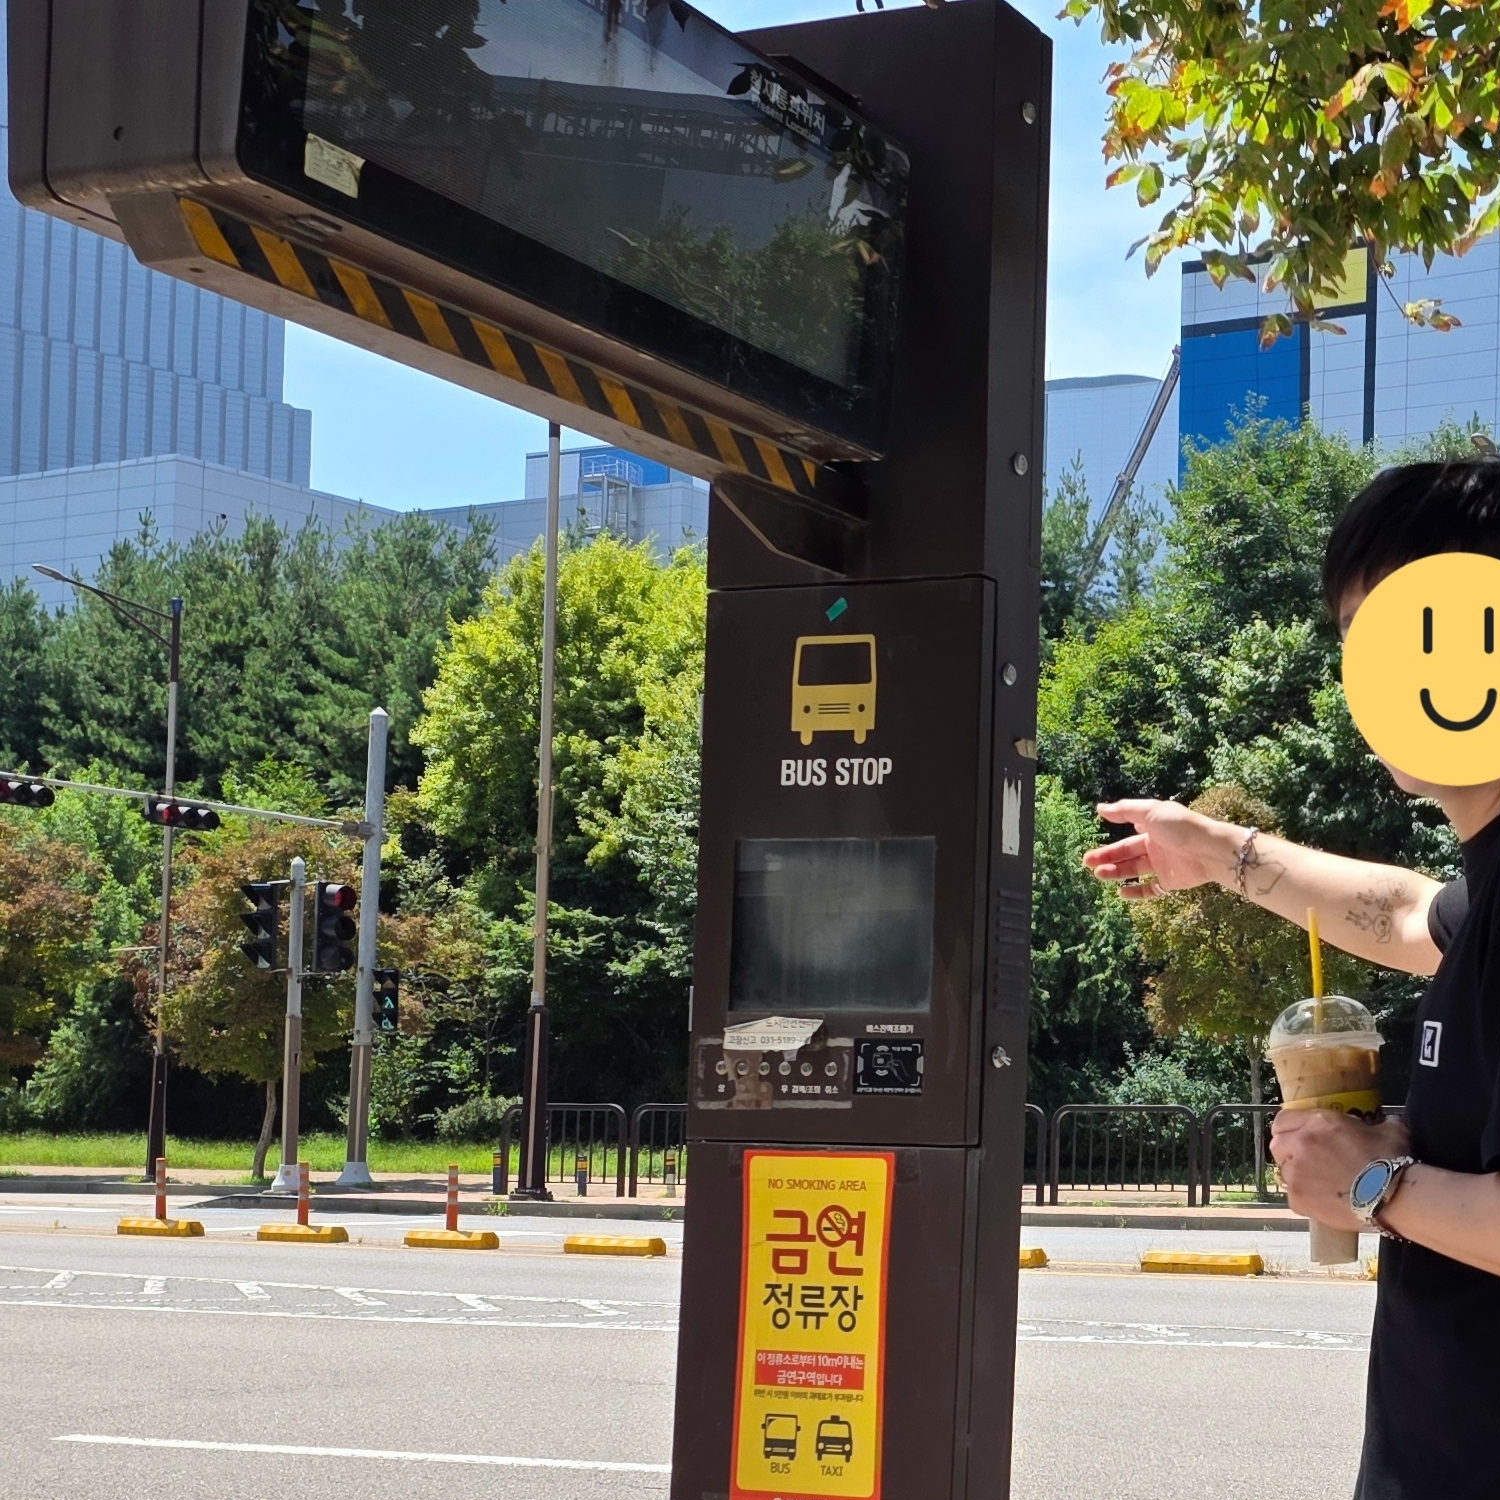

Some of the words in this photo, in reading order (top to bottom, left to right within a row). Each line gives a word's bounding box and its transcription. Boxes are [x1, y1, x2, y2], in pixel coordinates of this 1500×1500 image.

[780, 758, 827, 787] BUS
[835, 757, 893, 786] STOP
[767, 1178, 783, 1190] NO
[786, 1179, 836, 1191] SMOKING
[838, 1180, 867, 1192] AREA
[766, 1204, 866, 1276] 금연
[763, 1283, 864, 1332] 정류장
[757, 1352, 766, 1364] 이
[767, 1353, 815, 1367] 정류소로부터
[776, 1369, 843, 1386] 금연구역입니다
[770, 1462, 791, 1474] BUS
[820, 1465, 843, 1477] TAXI
